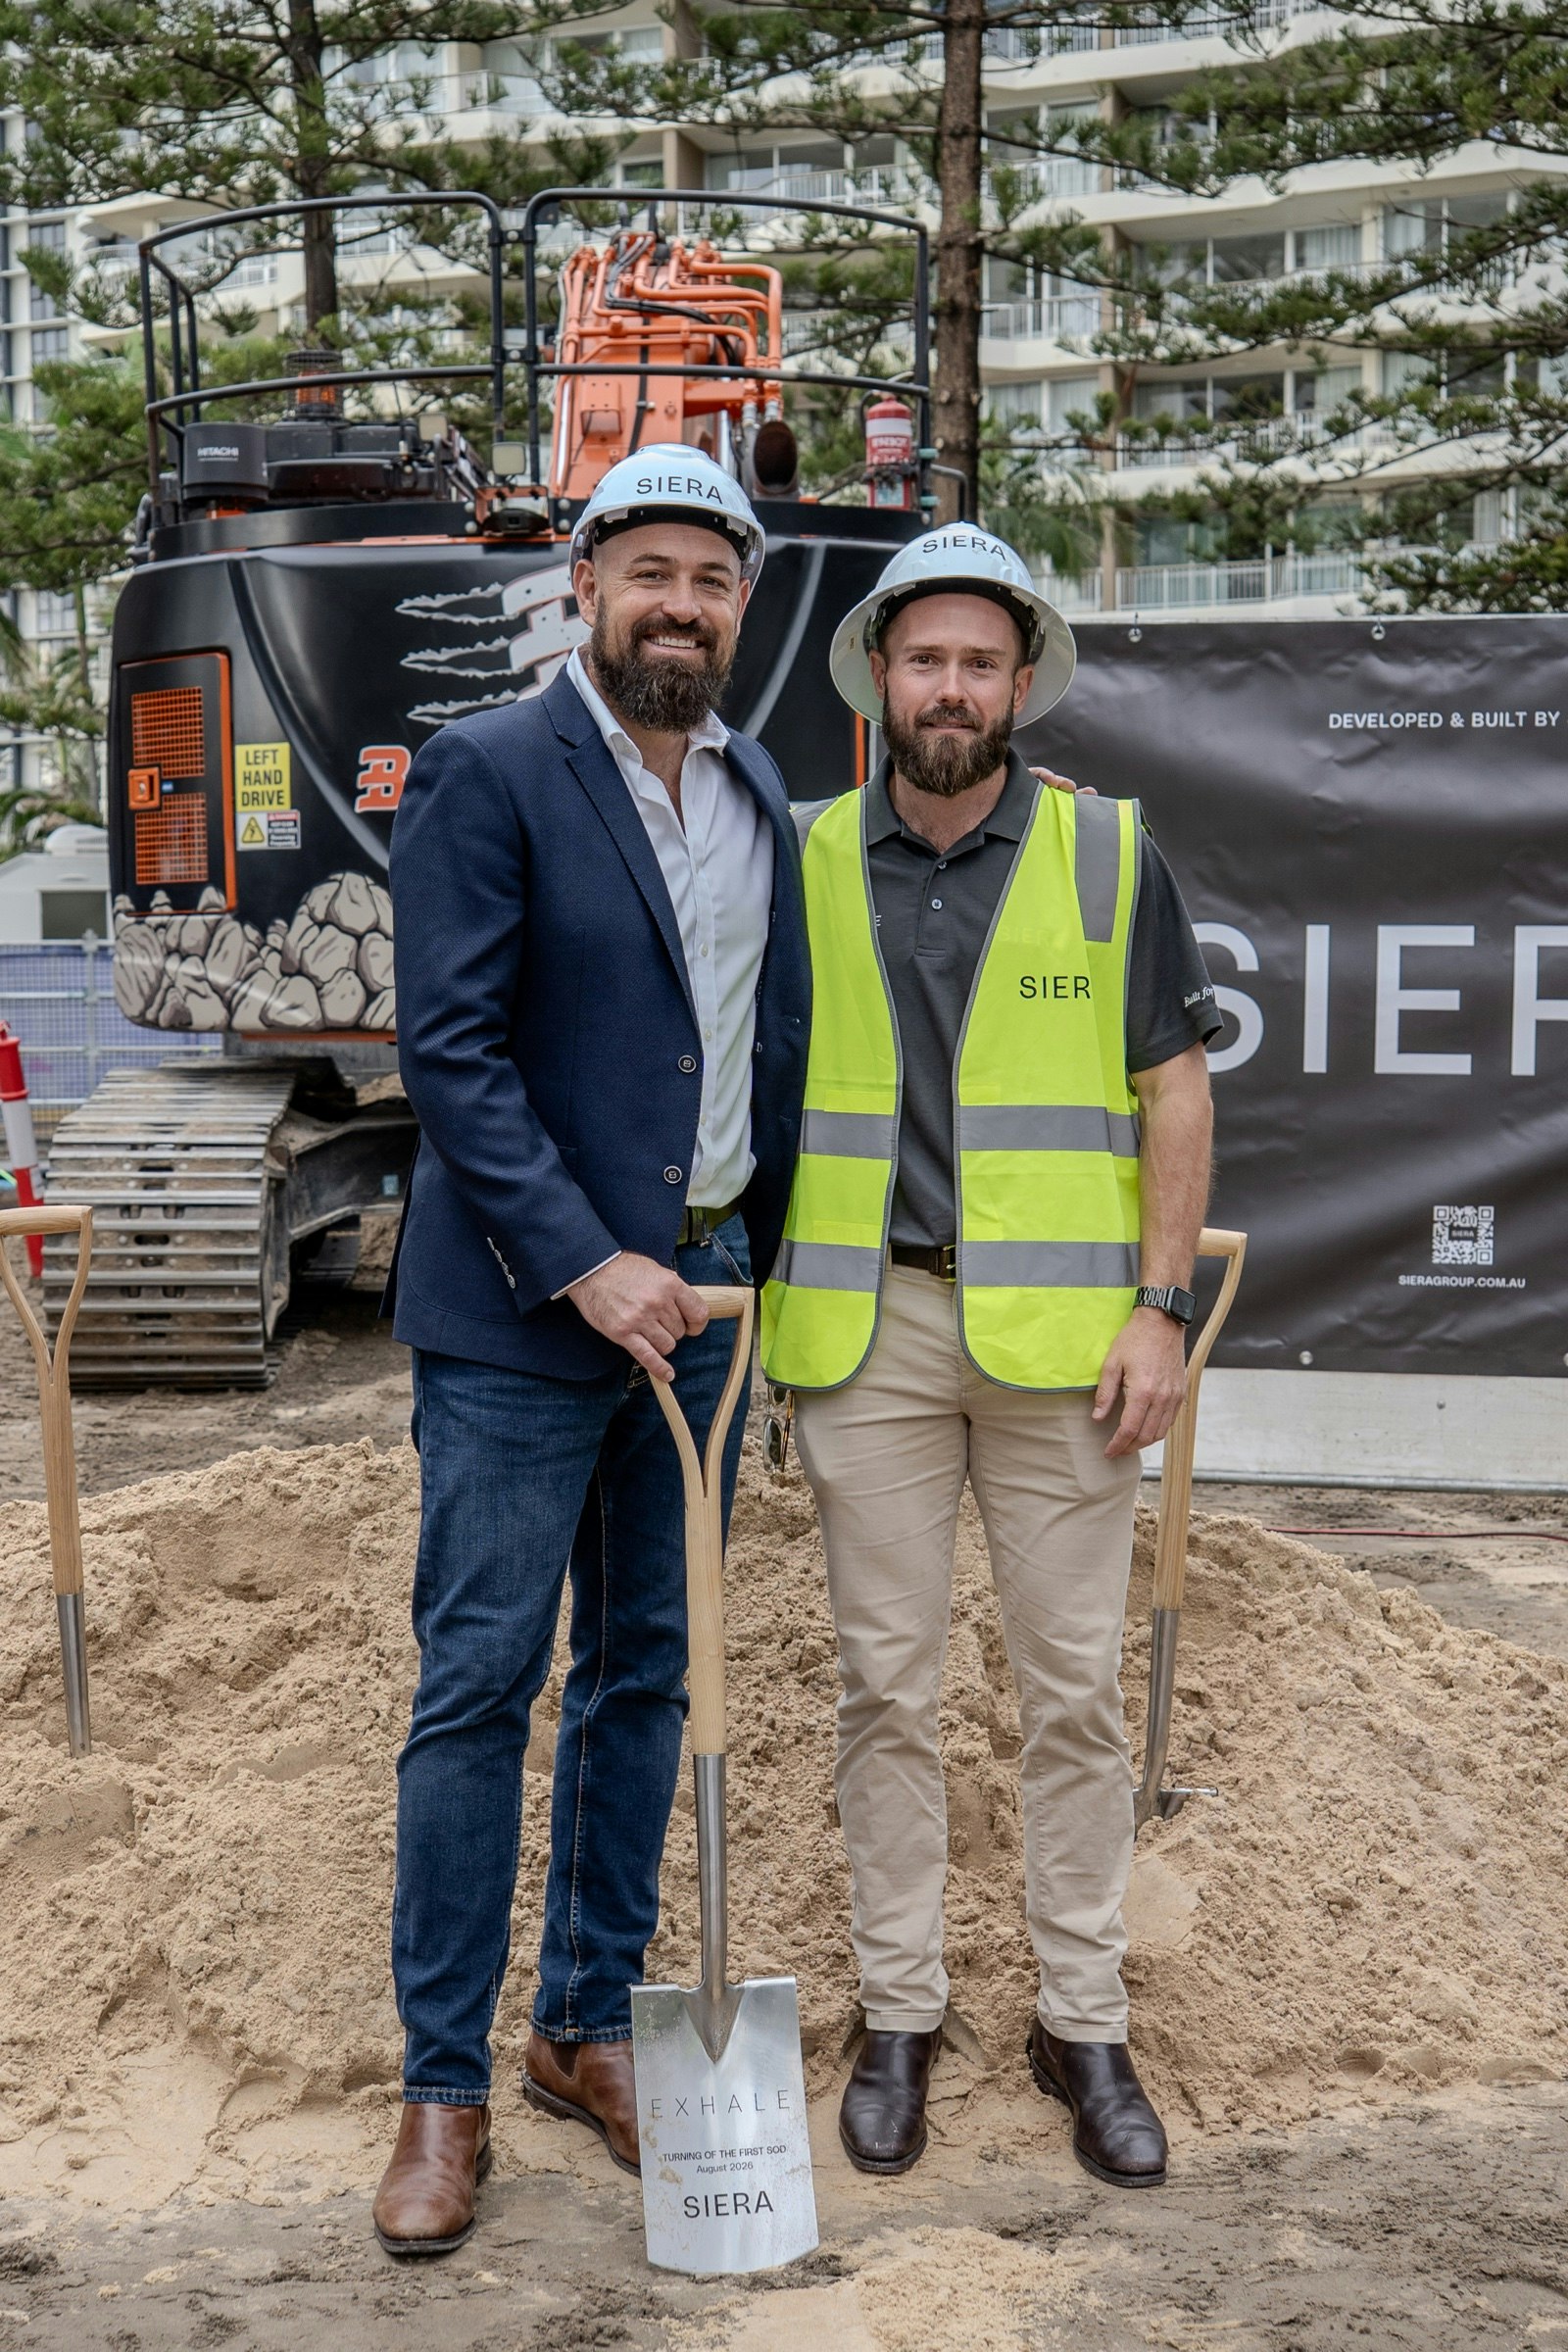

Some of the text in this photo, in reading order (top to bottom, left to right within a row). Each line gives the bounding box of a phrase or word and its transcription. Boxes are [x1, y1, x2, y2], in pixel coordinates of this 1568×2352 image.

[636, 476, 723, 505] SIERA
[922, 535, 1006, 562] SIERA
[1329, 710, 1561, 729] DEVELOPED & BUILT BY
[245, 749, 278, 765] LEFT
[243, 769, 282, 786] HAND
[241, 789, 284, 807] DRIVE
[1398, 1275, 1526, 1289] SIERAGROUP.COM.AU
[651, 2089, 791, 2119] EXHALE
[662, 2144, 787, 2163] TURNING OF THE FIRST SOD
[697, 2161, 754, 2175] August 2026
[683, 2190, 774, 2219] SIERA
